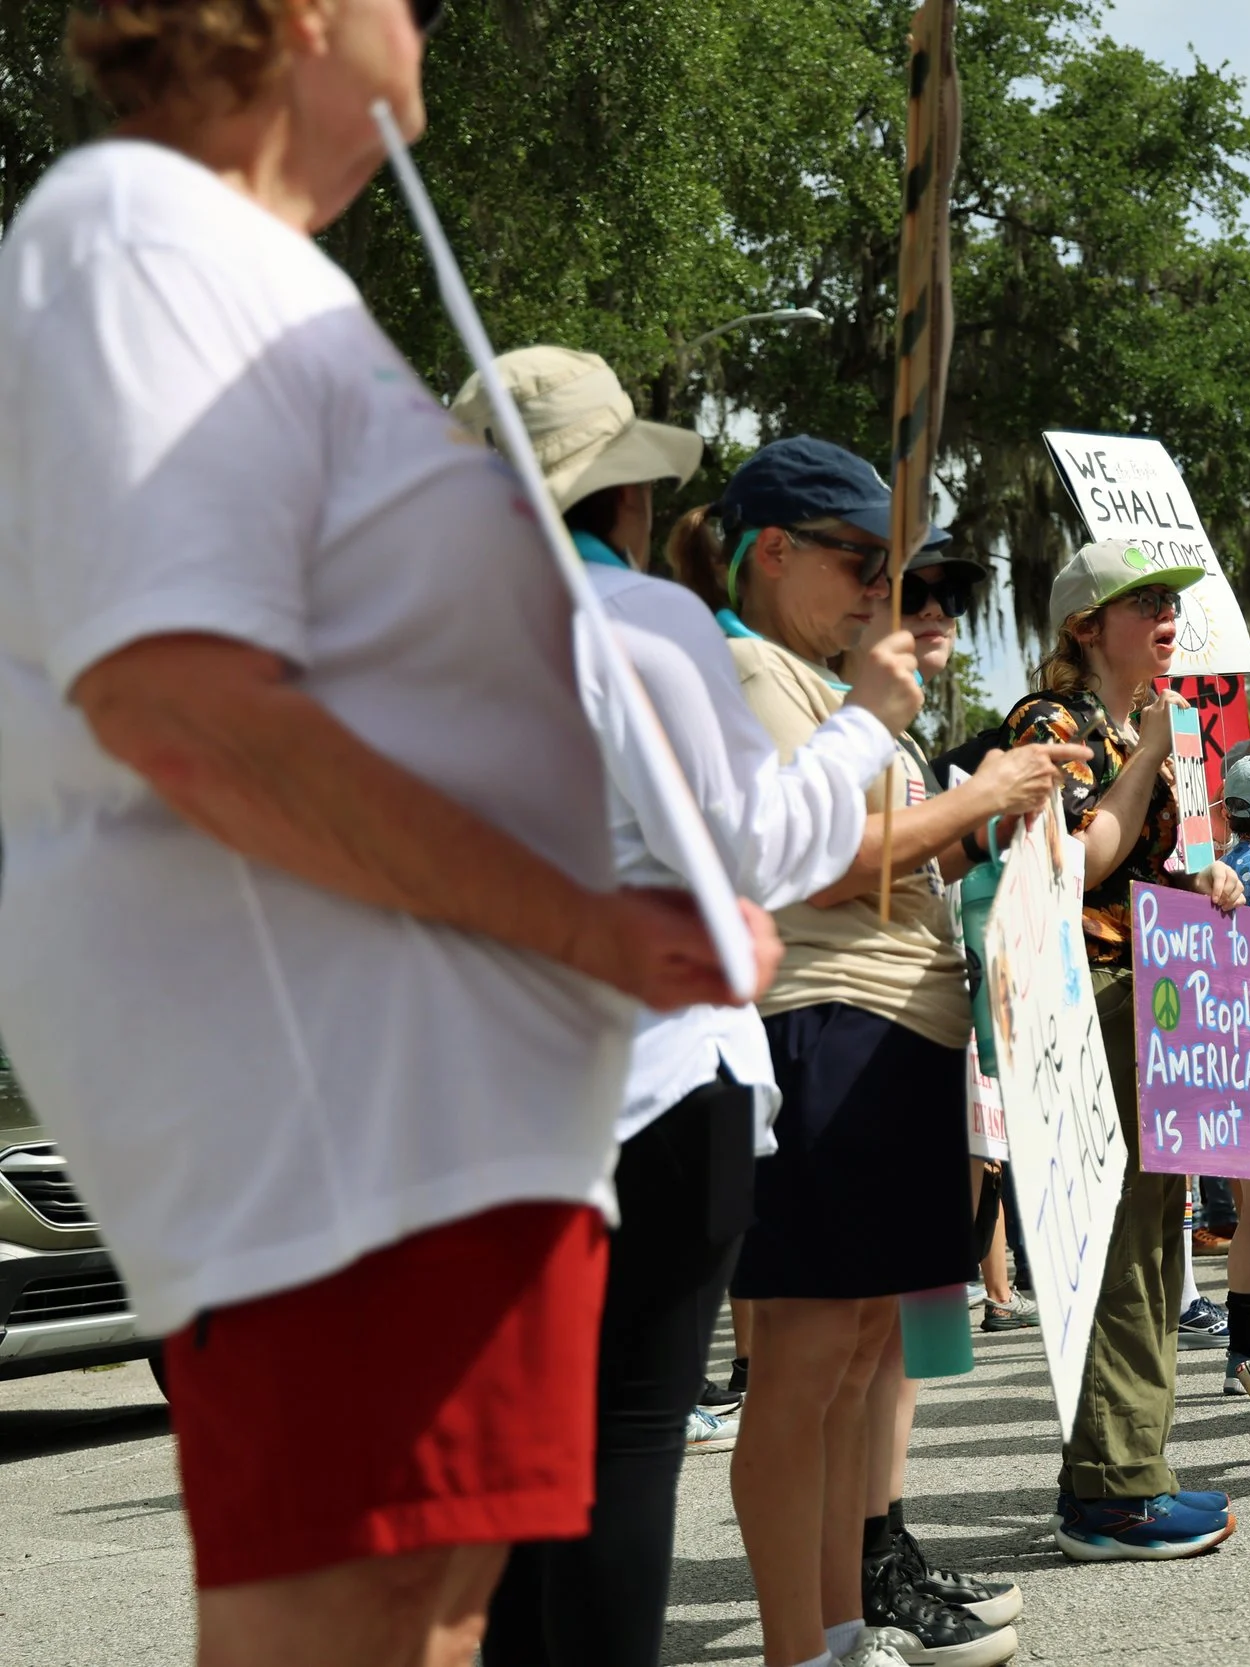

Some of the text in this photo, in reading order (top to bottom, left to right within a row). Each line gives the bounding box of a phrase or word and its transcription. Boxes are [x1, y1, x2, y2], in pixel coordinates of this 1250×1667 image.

[1065, 449, 1117, 483] WE
[1090, 487, 1195, 530] SHALL
[1106, 537, 1217, 577] RCOME
[1226, 910, 1248, 966] to
[1030, 1013, 1064, 1125] the
[973, 1102, 1006, 1140] EVASI
[1154, 1108, 1183, 1154] IS
[1036, 1014, 1117, 1358] ICE AGE
